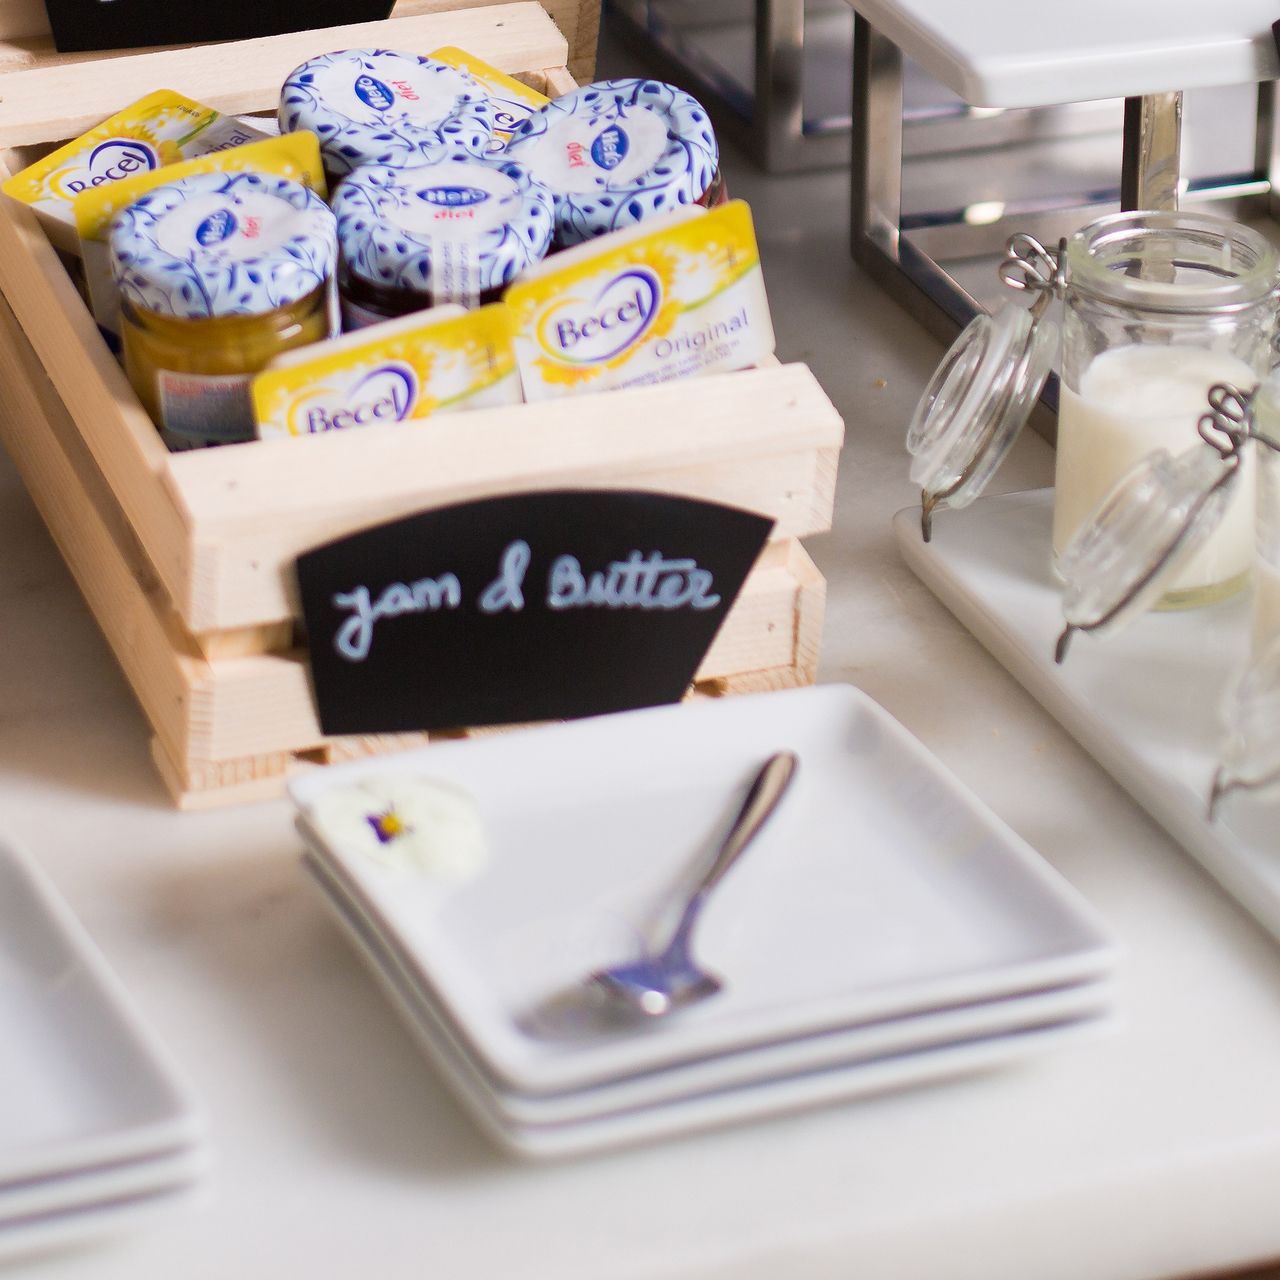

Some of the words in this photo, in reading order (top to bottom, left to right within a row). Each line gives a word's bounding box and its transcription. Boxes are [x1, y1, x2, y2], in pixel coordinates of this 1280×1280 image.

[556, 288, 649, 349] Becel
[654, 307, 749, 358] Original
[307, 384, 403, 434] Becel
[548, 551, 721, 609] Butter
